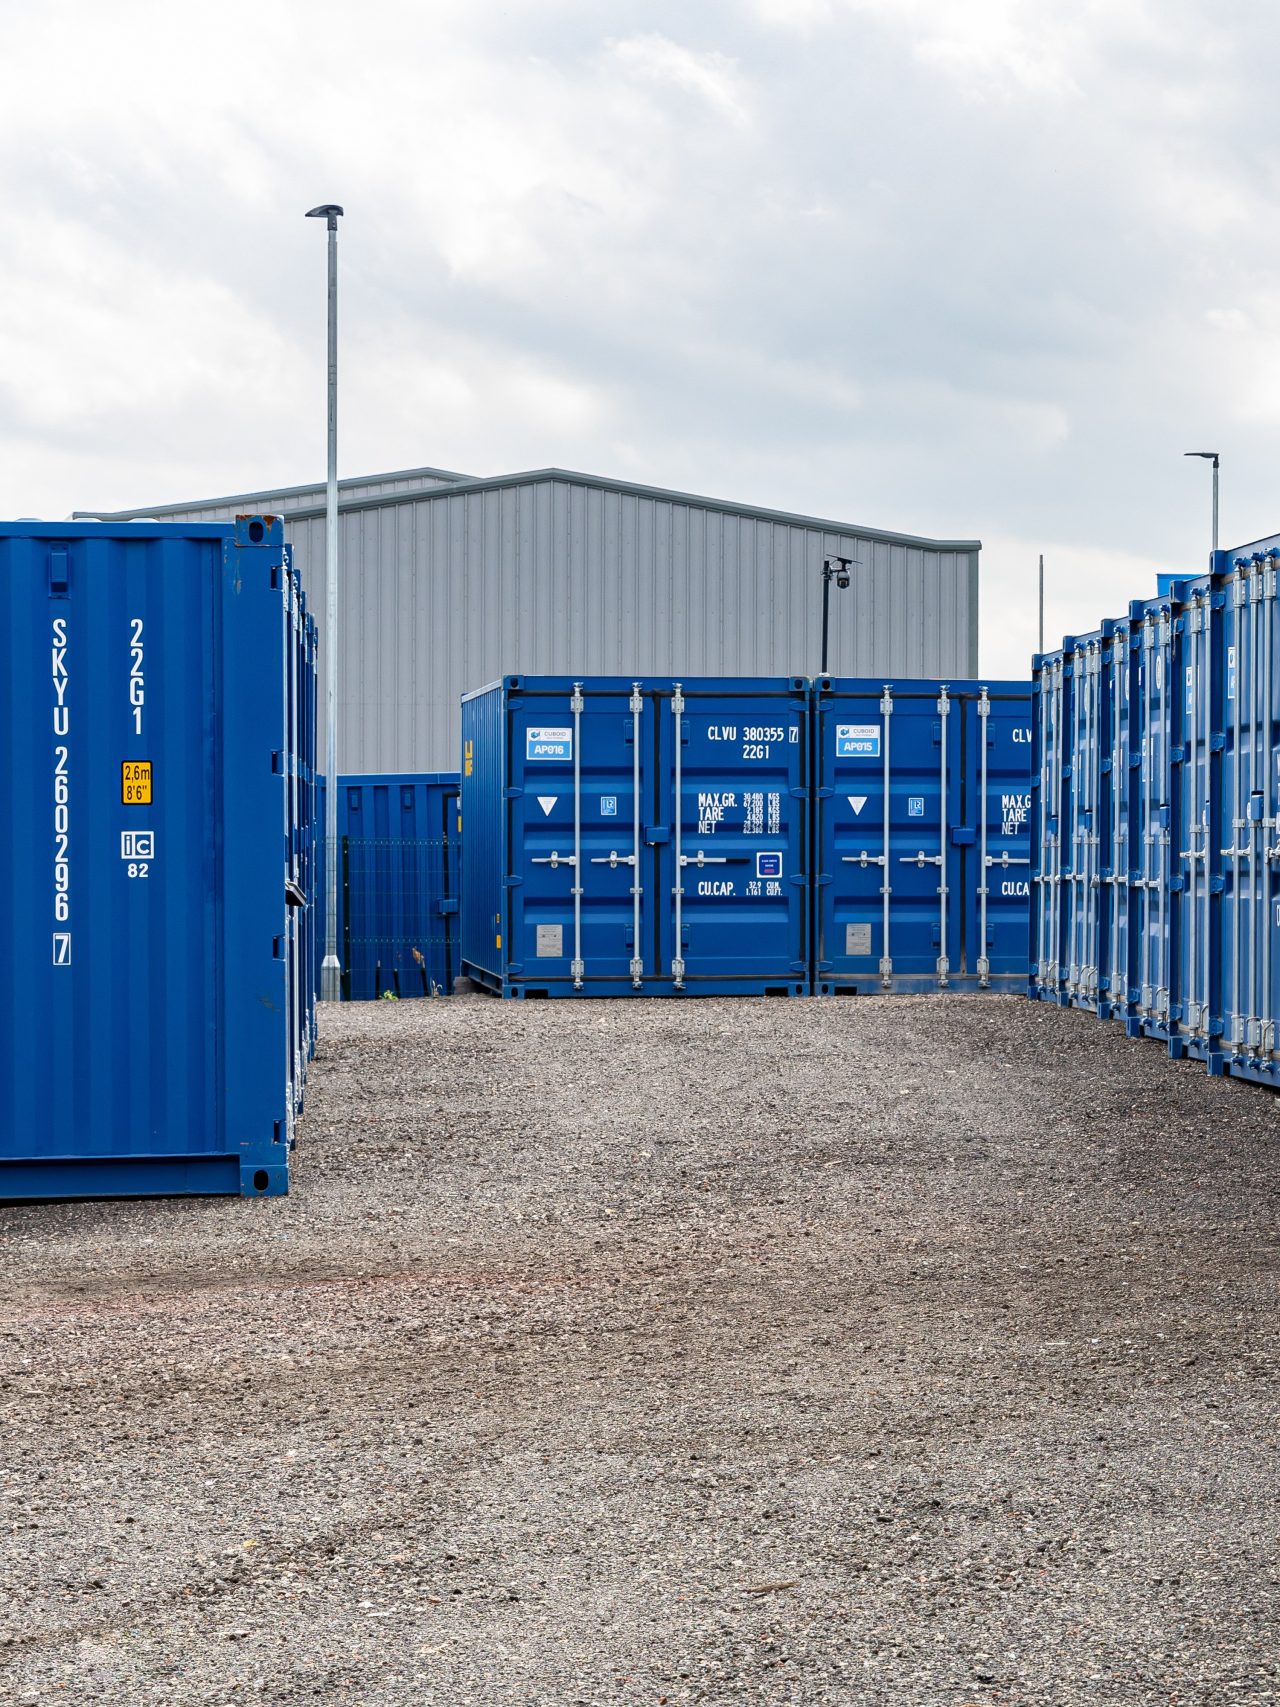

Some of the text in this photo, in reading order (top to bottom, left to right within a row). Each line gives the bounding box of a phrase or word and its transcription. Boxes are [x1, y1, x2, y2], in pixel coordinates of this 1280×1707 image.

[129, 618, 145, 735] 22G1
[707, 726, 799, 743] CLVU 380355 7
[1013, 729, 1032, 742] CLV
[742, 744, 769, 759] 22G1
[52, 618, 70, 965] SKYU 260296 7
[698, 793, 738, 807] MAX.GR.
[699, 807, 724, 820] TARE
[1002, 809, 1027, 822] TARE
[698, 821, 716, 834] NET
[1002, 822, 1019, 835] NET
[127, 863, 149, 878] 82
